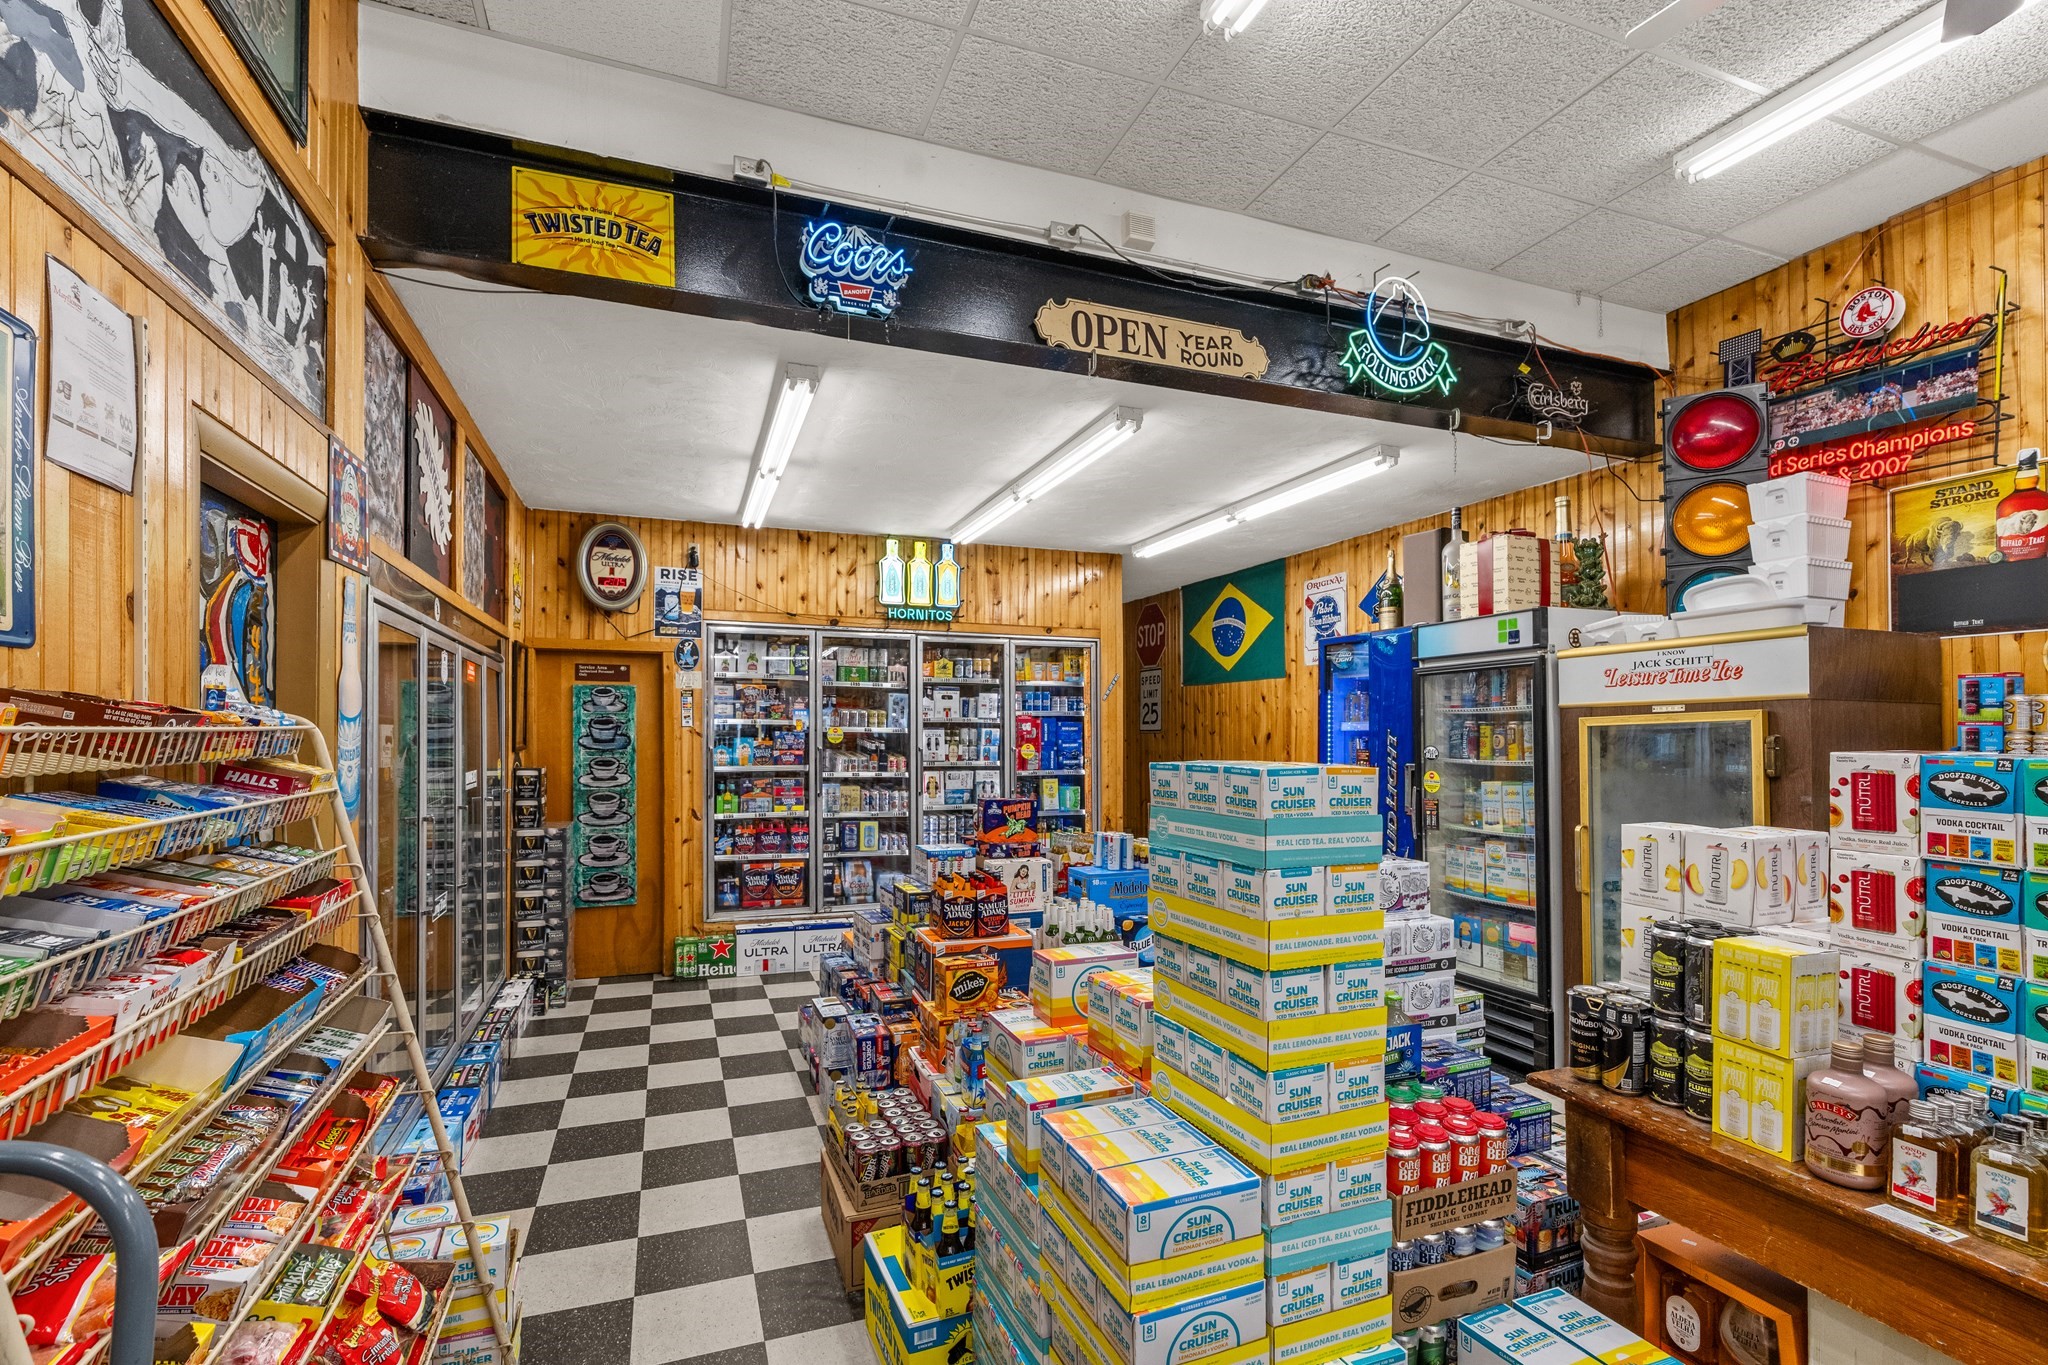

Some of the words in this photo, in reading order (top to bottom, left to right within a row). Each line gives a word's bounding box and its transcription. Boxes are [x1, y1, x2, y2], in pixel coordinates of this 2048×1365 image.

[590, 206, 612, 216] Original
[524, 212, 622, 240] TWISTED
[625, 222, 662, 257] TEA
[574, 236, 590, 244] Hard
[591, 237, 604, 245] Iced
[605, 240, 616, 248] Tea
[808, 222, 913, 274] Coors
[1848, 290, 1889, 312] BOSTON
[1847, 323, 1864, 334] RED
[1869, 316, 1885, 332] SOX
[1070, 309, 1168, 361] OPEN
[1178, 329, 1233, 352] YEAR
[1179, 348, 1244, 368] ROUND
[1759, 313, 1988, 393] Budweiser
[1358, 343, 1408, 388] ROLLING
[1408, 357, 1438, 386] ROCK
[1527, 382, 1589, 415] Carlsberg
[15, 376, 32, 461] Anchor
[1775, 440, 1785, 449] 27
[1789, 438, 1799, 446] 42
[1787, 447, 1847, 473] Series
[1849, 421, 1976, 459] Champions
[1859, 454, 1913, 480] 2007
[1935, 480, 1993, 499] STAND
[15, 465, 31, 533] Steam
[1930, 488, 2000, 509] STRONG
[2000, 538, 2022, 548] BUFFALO
[2028, 536, 2045, 545] TRACE
[592, 552, 631, 562] Michelob
[15, 537, 32, 593] Beer
[660, 568, 697, 581] RISE
[1307, 575, 1344, 590] ORIGINAL
[888, 607, 953, 620] HORNITOS
[1317, 602, 1334, 614] Pabst
[1137, 622, 1164, 648] STOP
[1631, 659, 1660, 671] JACK
[1665, 655, 1714, 667] SCHITT
[1141, 675, 1161, 686] SPEED
[1604, 668, 1668, 688] Leisure
[1670, 667, 1710, 684] Time
[1712, 659, 1744, 682] Ice
[1143, 689, 1158, 698] LIMIT
[1142, 703, 1158, 725] 25
[224, 770, 279, 789] HALLS
[1978, 778, 2001, 790] HEAD
[147, 799, 195, 812] Trident
[1003, 801, 1032, 815] PUMPKIN
[1270, 798, 1316, 810] CRUISER
[1329, 798, 1372, 809] CRUISER
[1948, 797, 1988, 806] COCKTAILS
[1936, 818, 1963, 828] VODKA
[1965, 820, 2005, 831] COCKTAIL
[1295, 838, 1310, 846] ICED
[1741, 842, 1747, 850] 4
[1114, 881, 1147, 894] Modelo
[1286, 882, 1307, 893] SUN
[1345, 882, 1365, 892] SUN
[1945, 878, 1982, 889] DOGFISH
[1984, 887, 2007, 900] HEAD
[977, 900, 1009, 910] SAMUEL
[1273, 894, 1318, 907] CRUISER
[1333, 893, 1375, 905] CRUISER
[943, 903, 975, 912] SAMUEL
[981, 908, 1006, 917] ADAMS
[945, 910, 973, 920] ADAMS
[1412, 924, 1423, 944] WHITE
[1423, 924, 1434, 934] CLAW
[1941, 923, 1968, 934] VODKA
[1970, 927, 2010, 941] COCKTAIL
[750, 938, 780, 947] Michelob
[1131, 938, 1150, 951] BLUE
[1275, 942, 1293, 951] REAL
[1294, 938, 1334, 949] LEMONADE.
[1335, 936, 1352, 944] REAL
[1355, 934, 1378, 942] VODKA.
[744, 946, 788, 958] ULTRA
[1420, 963, 1435, 971] SELTZER
[953, 978, 985, 995] mike's
[1653, 979, 1676, 988] FLUME
[1753, 976, 1779, 990] SPRITZ
[150, 985, 171, 1000] Kinder
[1653, 1068, 1676, 1079] FLUME
[1811, 1102, 1853, 1119] BAILEYS
[1830, 1126, 1858, 1135] Martini
[316, 1126, 342, 1150] Reese's
[1900, 1145, 1927, 1157] CONDE
[199, 1141, 234, 1180] MUSKETEERS
[1986, 1171, 2016, 1184] CONDE
[865, 1184, 896, 1199] HARDER
[1175, 1196, 1197, 1204] BLUEBERRY
[1198, 1190, 1221, 1200] LEMONADE
[1405, 1178, 1512, 1218] FIDDLEHEAD
[1405, 1208, 1458, 1228] BREWING
[1461, 1194, 1511, 1212] COMPANY
[1140, 1216, 1147, 1225] 8
[1187, 1214, 1212, 1228] SUN
[1430, 1216, 1462, 1228] SHELBURNE,
[1463, 1209, 1488, 1219] VERMONT
[1173, 1242, 1201, 1253] LEMONADE
[1204, 1237, 1223, 1245] VODKA
[300, 1257, 341, 1301] Chuckles
[1670, 1310, 1696, 1329] ALDEIA
[1672, 1319, 1695, 1336] VELHA
